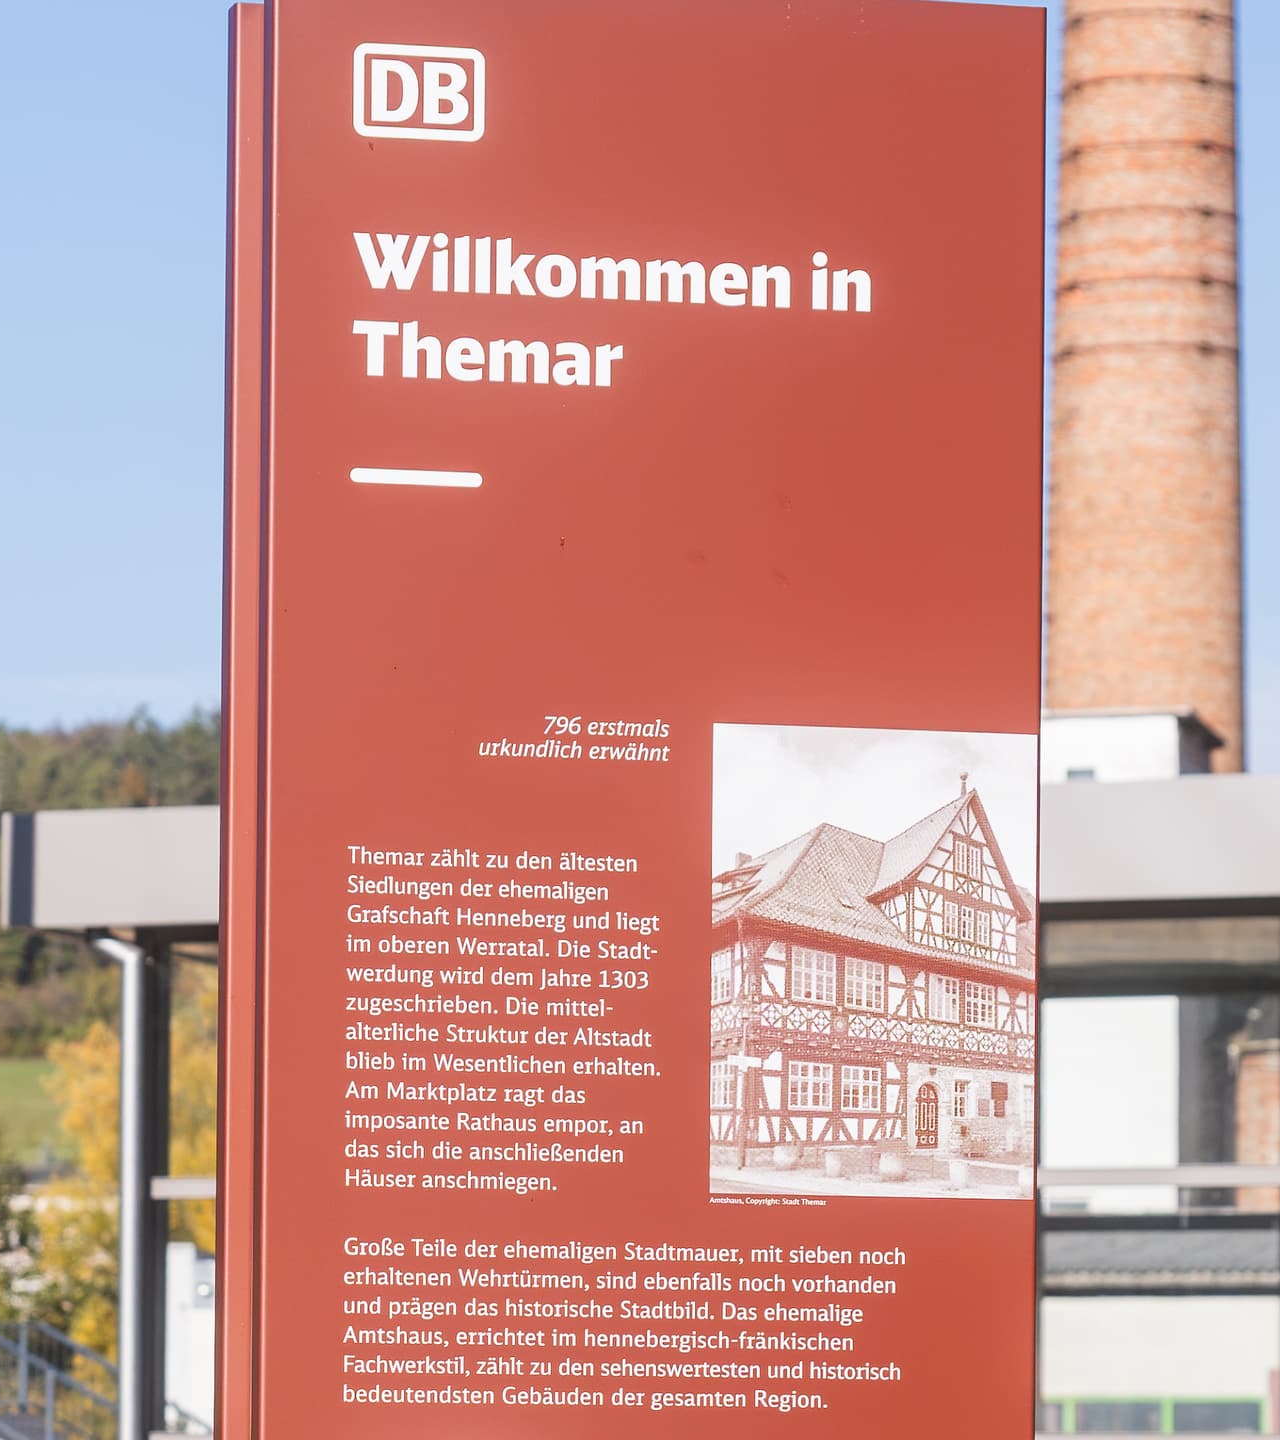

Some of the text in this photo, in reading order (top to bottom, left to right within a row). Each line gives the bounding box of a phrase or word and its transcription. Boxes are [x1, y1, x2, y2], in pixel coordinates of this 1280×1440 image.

[370, 58, 471, 126] DB
[352, 232, 872, 313] Willkommen in
[352, 319, 624, 387] Themar
[543, 715, 670, 738] 796 erstmals
[478, 738, 671, 762] urkundlich erwähnt
[347, 845, 638, 873] Themar zählt zu den ältesten
[347, 874, 609, 905] Siedlungen der ehemaligen
[347, 904, 660, 936] Grafschaft Henneberg und liegt
[346, 963, 649, 991] werdung wird dem Jahre 1303
[345, 1021, 653, 1048] alterliche Struktur der Altstadt
[346, 1050, 661, 1077] blieb im Wesentlichen erhalten.
[344, 1138, 624, 1163] das sich die anschließenden
[345, 1168, 557, 1195] Häuser anschmiegen.
[343, 1236, 906, 1265] Große Teile der ehemaligen Stadtmauer, mit sieben noch
[343, 1296, 864, 1327] und prägen das historische Stadtbild. Das ehemalige
[342, 1325, 854, 1353] Amtshaus, errichtet im hennebergisch-fränkischen
[343, 1383, 828, 1413] bedeutendsten Gebäuden der gesamten Region.
